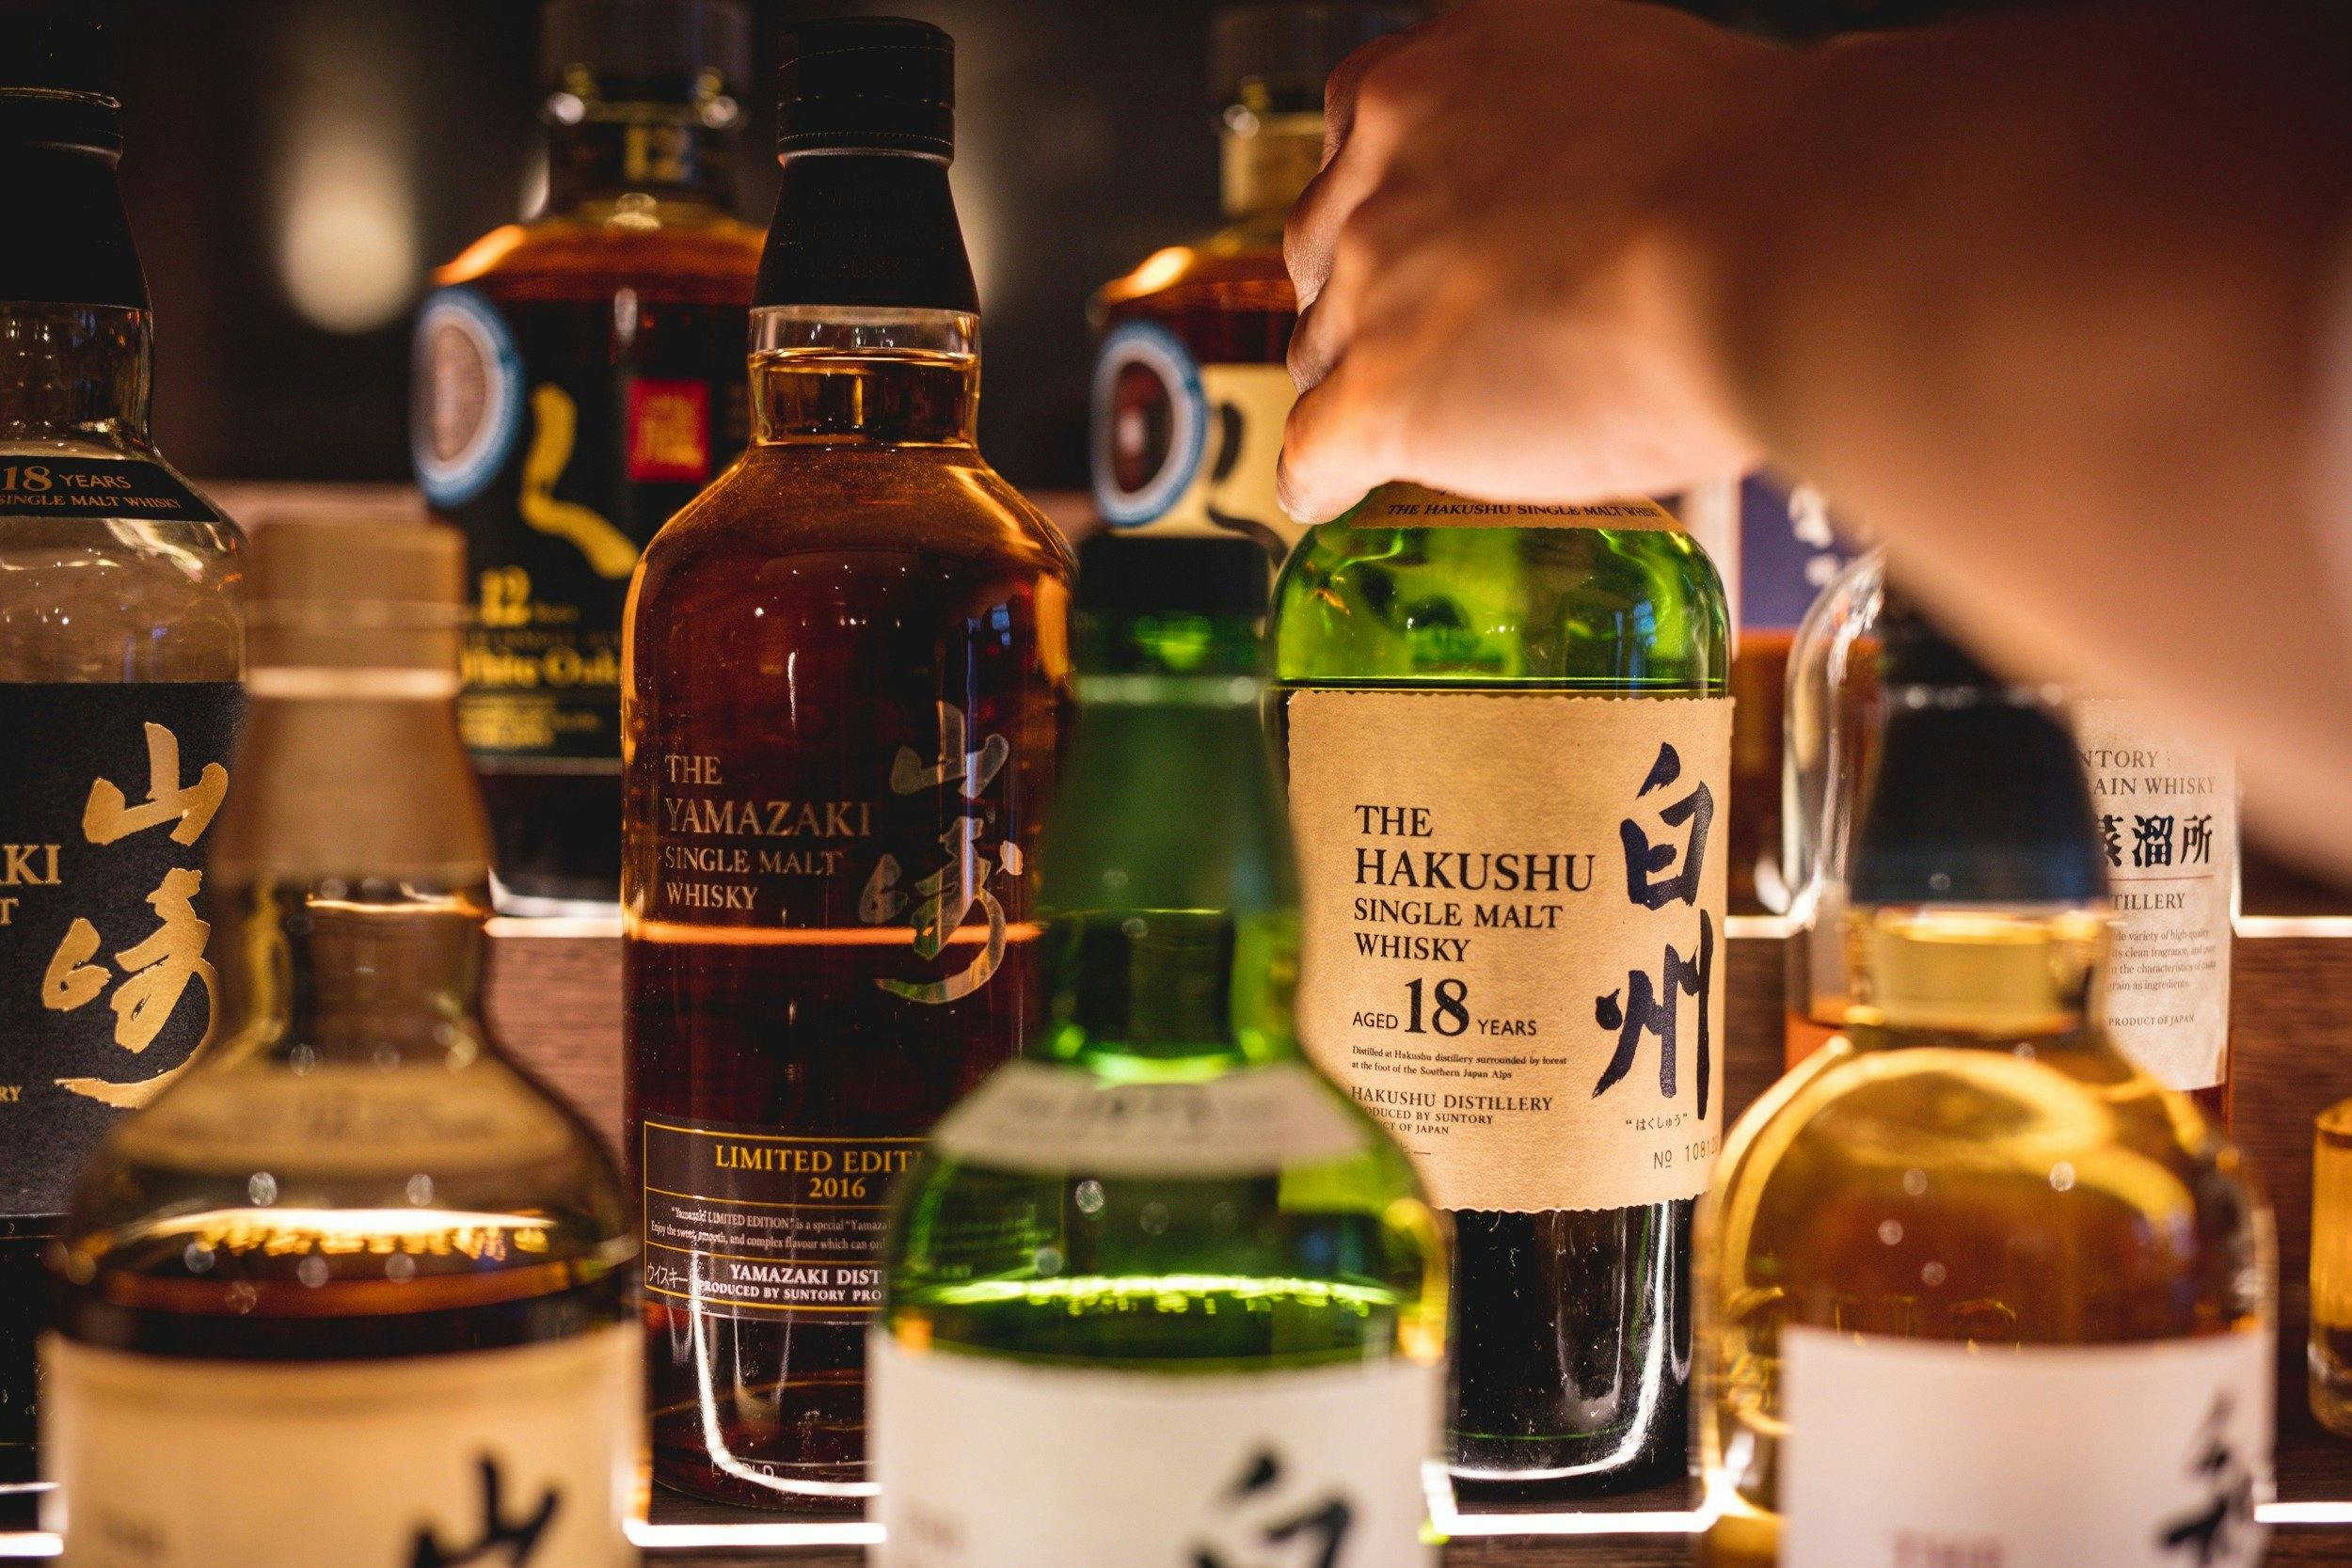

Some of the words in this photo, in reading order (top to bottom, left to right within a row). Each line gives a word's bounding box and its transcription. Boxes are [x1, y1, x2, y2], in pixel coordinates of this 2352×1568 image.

[2, 465, 54, 492] 18
[58, 473, 132, 490] YEARS
[0, 495, 66, 507] SINGLE
[71, 496, 120, 507] MALT
[123, 497, 183, 509] WHISKY
[1388, 504, 1420, 515] THE
[1424, 504, 1512, 515] HAKUSHU
[1517, 504, 1581, 515] SINGLE
[1583, 505, 1623, 516] MALT
[665, 754, 723, 785] THE
[2093, 777, 2137, 795] AIN
[2144, 776, 2217, 795] WHISKY
[664, 797, 872, 837] YAMAZAKI
[1354, 804, 1435, 837] THE
[0, 844, 62, 885] KI
[664, 846, 751, 874] SINGLE
[758, 849, 844, 876] MALT
[1354, 847, 1596, 892] HAKUSHU
[667, 880, 758, 911] WHISKY
[1354, 897, 1463, 927] SINGLE
[1473, 903, 1564, 929] MALT
[1591, 740, 1715, 1121] 白州
[2129, 930, 2158, 942] variety
[1353, 932, 1471, 962] WHISKY
[2125, 947, 2149, 958] clean
[2151, 946, 2189, 958] fragrance,
[2120, 964, 2135, 974] the
[2133, 981, 2143, 990] as
[1352, 1010, 1400, 1030] AGED
[1404, 976, 1471, 1037] 18
[1477, 1019, 1538, 1037] YEARS
[2108, 1016, 2154, 1027] PRODUCT
[2156, 1015, 2169, 1025] OF
[2169, 1013, 2195, 1026] JAPAN
[1352, 1045, 1384, 1058] Distilled
[1385, 1050, 1393, 1058] at
[1394, 1050, 1432, 1061] Hakushu
[1435, 1052, 1473, 1064] distillery
[1475, 1054, 1526, 1065] surrounded
[1529, 1055, 1540, 1066] by
[1541, 1055, 1567, 1065] forest
[1352, 1060, 1360, 1069] at
[1360, 1061, 1373, 1070] the
[1375, 1062, 1391, 1072] foot
[1392, 1064, 1402, 1073] of
[1403, 1065, 1418, 1074] the
[1420, 1066, 1460, 1077] Southern
[1463, 1069, 1488, 1080] Japan
[1492, 1069, 1513, 1080] Alps
[1351, 1085, 1436, 1107] HAKUSHU
[1443, 1093, 1553, 1112] DISTILLERY
[1363, 1104, 1411, 1119] ODUCED
[1416, 1112, 1431, 1121] BY
[1435, 1113, 1494, 1124] SUNTORY
[1380, 1120, 1395, 1131] CT
[1399, 1122, 1413, 1132] OF
[1415, 1124, 1450, 1135] JAPAN
[715, 1144, 834, 1173] LIMITED
[842, 1149, 923, 1174] EDIT
[808, 1177, 866, 1199] 2016
[707, 1211, 746, 1226] LIMITED
[813, 1220, 845, 1233] special
[651, 1221, 667, 1237] Enjoy
[667, 1224, 676, 1237] the
[730, 1233, 745, 1244] and
[747, 1235, 784, 1250] complex
[785, 1237, 818, 1249] flavour
[819, 1238, 849, 1250] which
[850, 1241, 867, 1250] can
[729, 1263, 829, 1286] YAMAZAKI
[835, 1268, 882, 1286] DIST
[698, 1279, 760, 1297] PRODUCED
[763, 1285, 782, 1299] BY
[783, 1289, 846, 1302] SUNTORY
[851, 1290, 882, 1302] PRO
